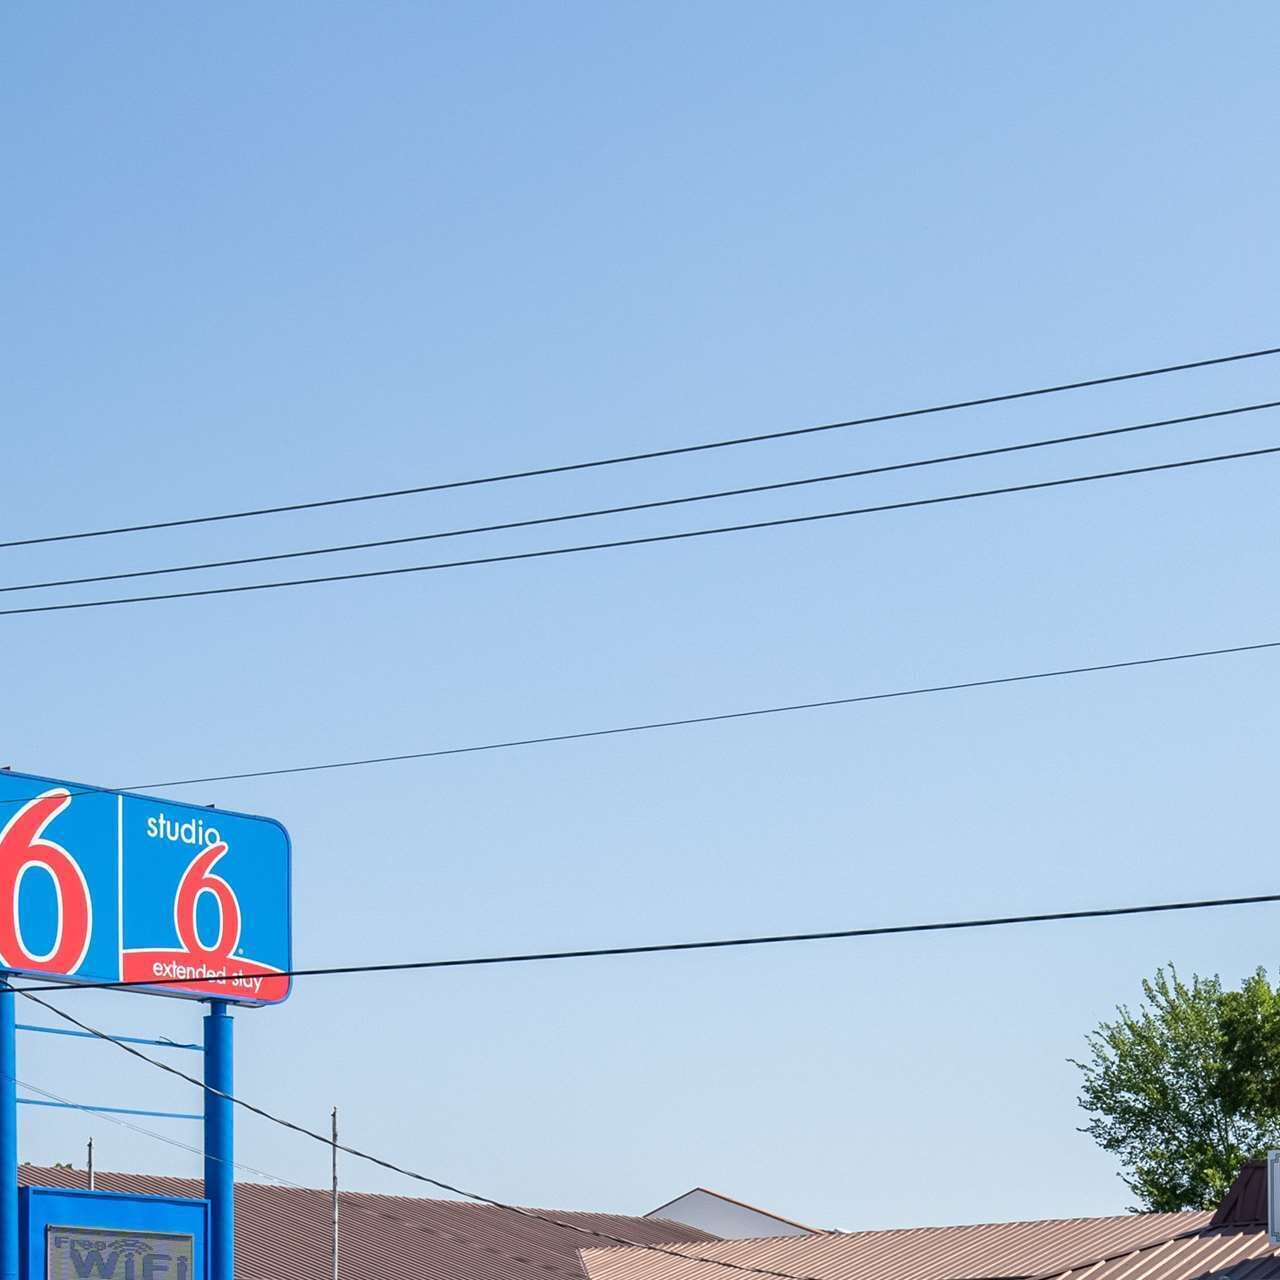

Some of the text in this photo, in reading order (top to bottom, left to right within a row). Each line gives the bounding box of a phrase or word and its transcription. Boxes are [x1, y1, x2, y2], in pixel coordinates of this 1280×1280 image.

[146, 813, 220, 845] studio
[174, 842, 241, 958] 6
[152, 960, 263, 993] extended stay
[54, 1236, 106, 1250] Free
